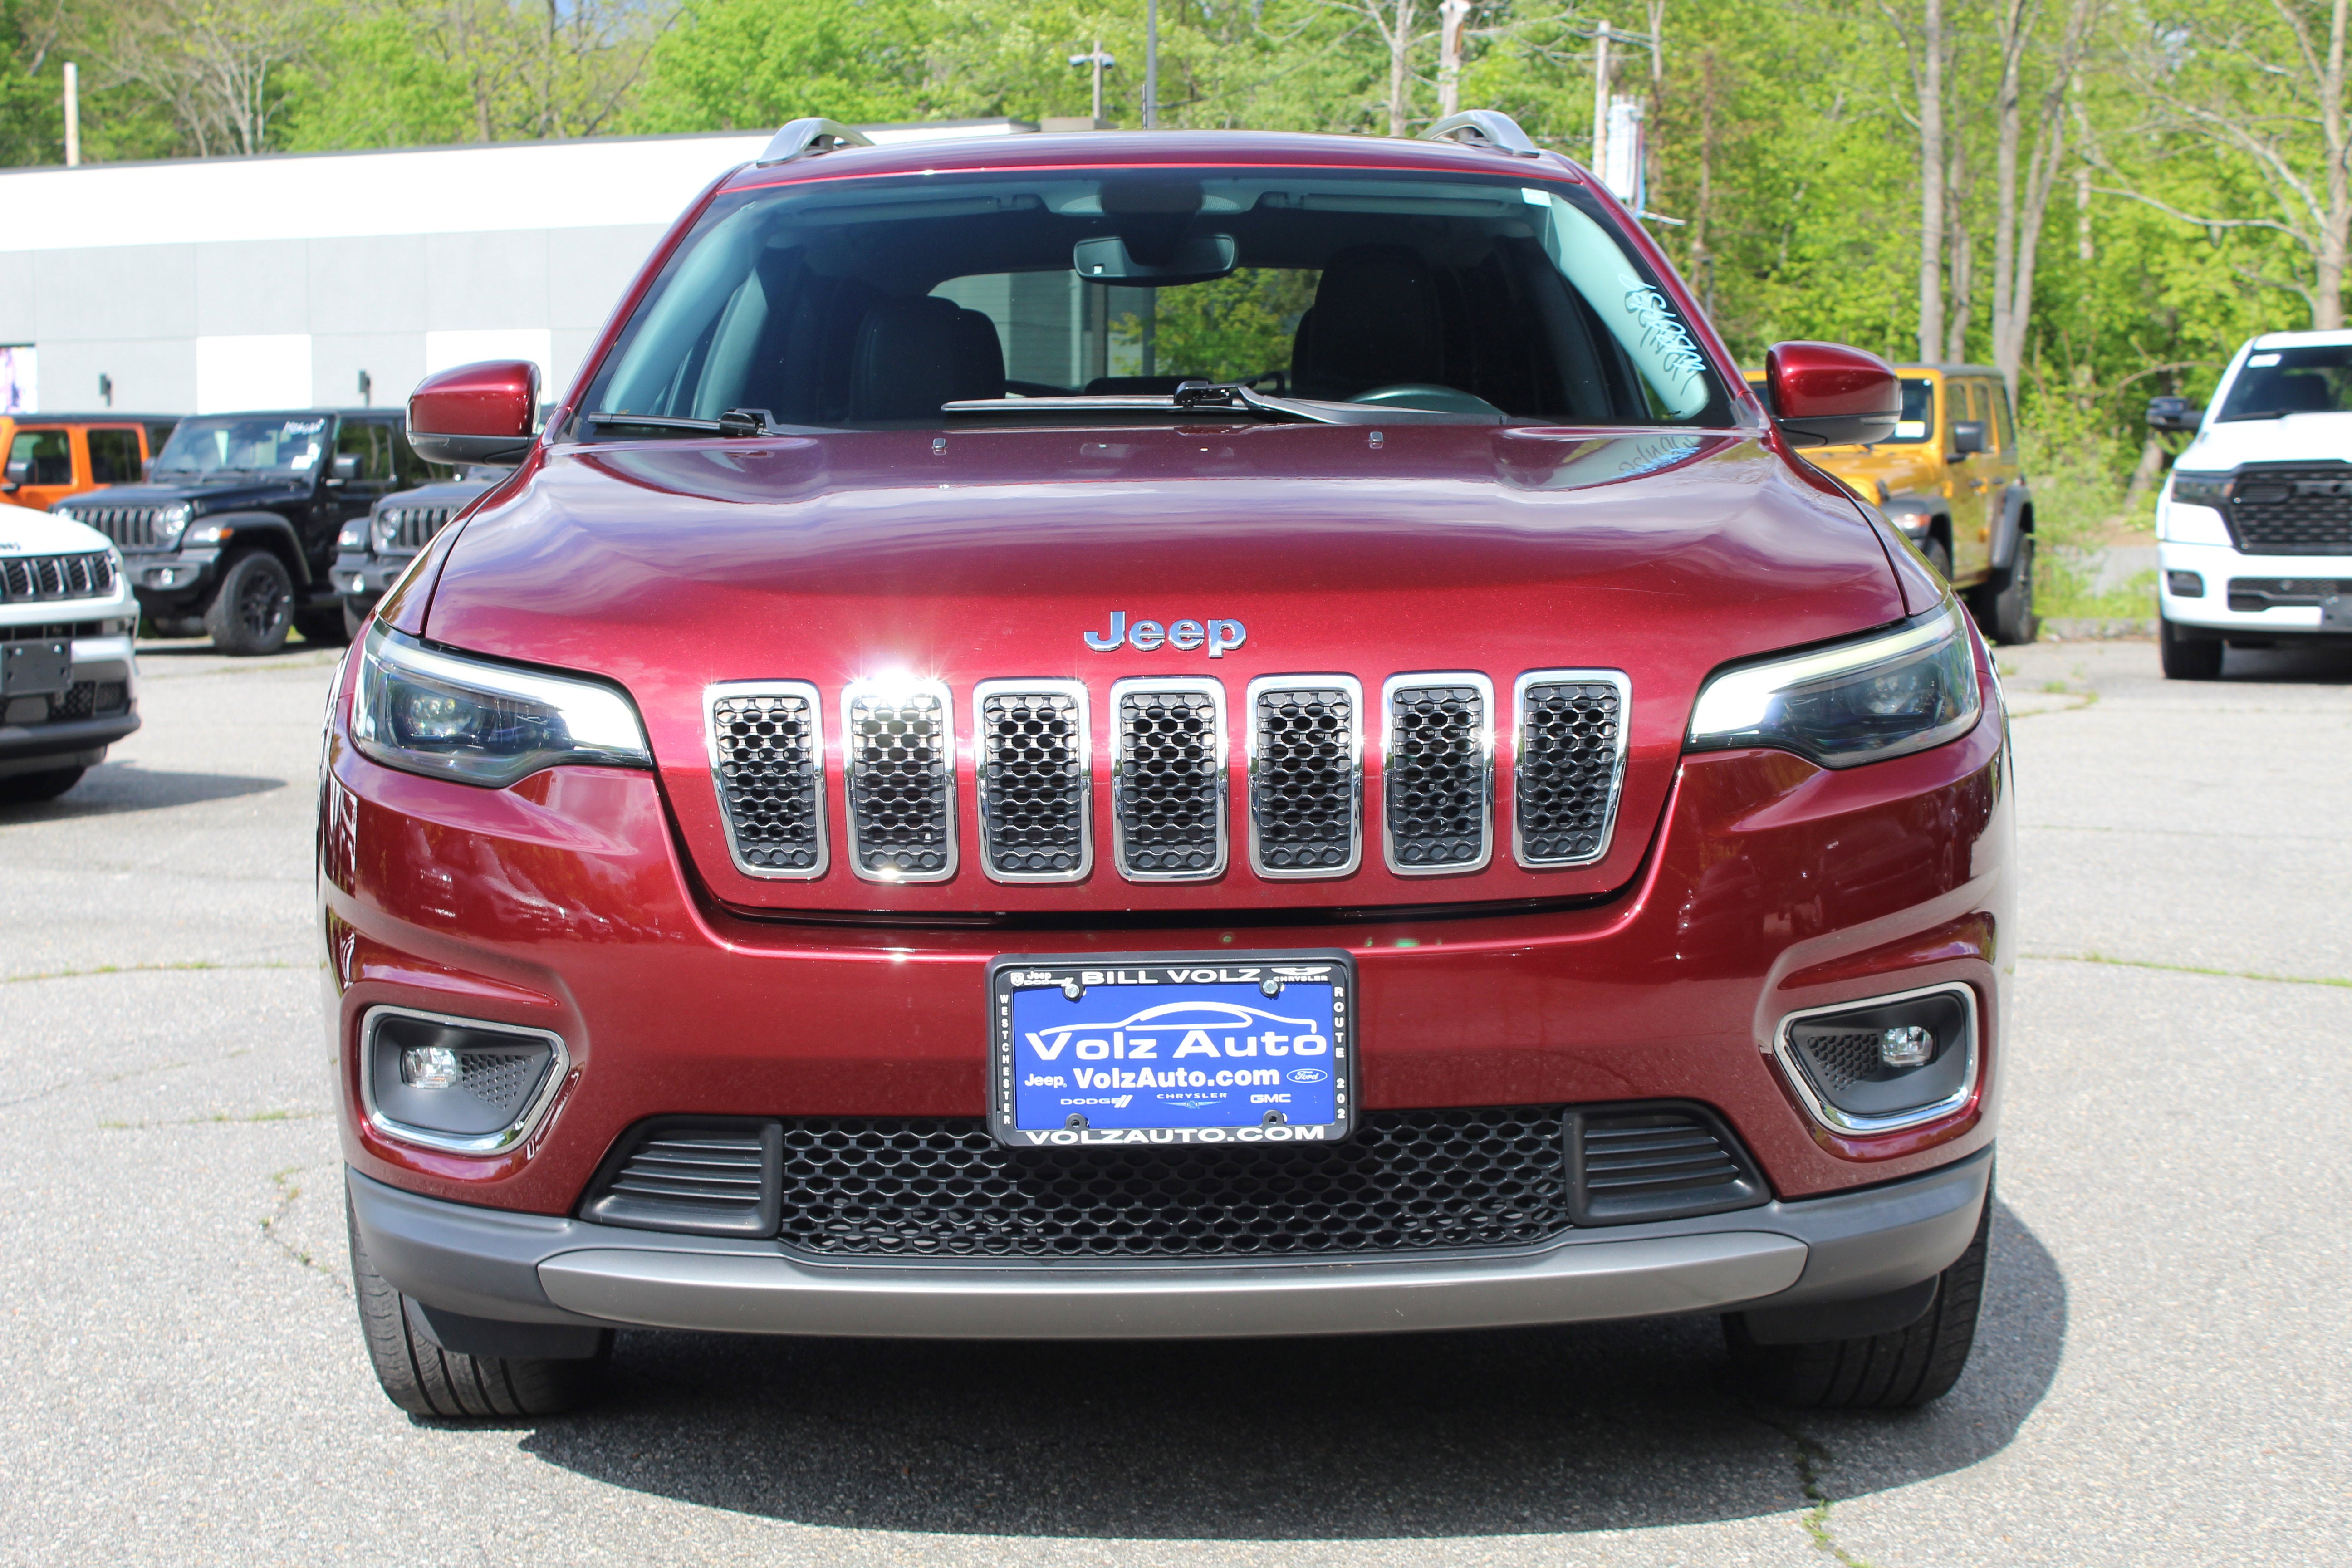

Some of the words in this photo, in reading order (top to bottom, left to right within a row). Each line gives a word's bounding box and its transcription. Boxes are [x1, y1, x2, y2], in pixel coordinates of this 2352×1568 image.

[1084, 611, 1247, 658] Jeep
[1027, 971, 1051, 980] Jeep
[1081, 970, 1158, 985] BILL
[1167, 968, 1261, 983] VOLZ
[1333, 987, 1345, 1058] ROUTE
[1024, 1032, 1157, 1060] Volz
[1172, 1030, 1327, 1058] Auto
[1000, 994, 1011, 1125] WESTCHESTER
[1024, 1073, 1064, 1088] Jeep
[1073, 1067, 1280, 1089] VolzAuto.com
[1250, 1093, 1292, 1103] GMC
[1336, 1078, 1346, 1119] 202
[1026, 1126, 1324, 1145] VOLZAUTO.COM
